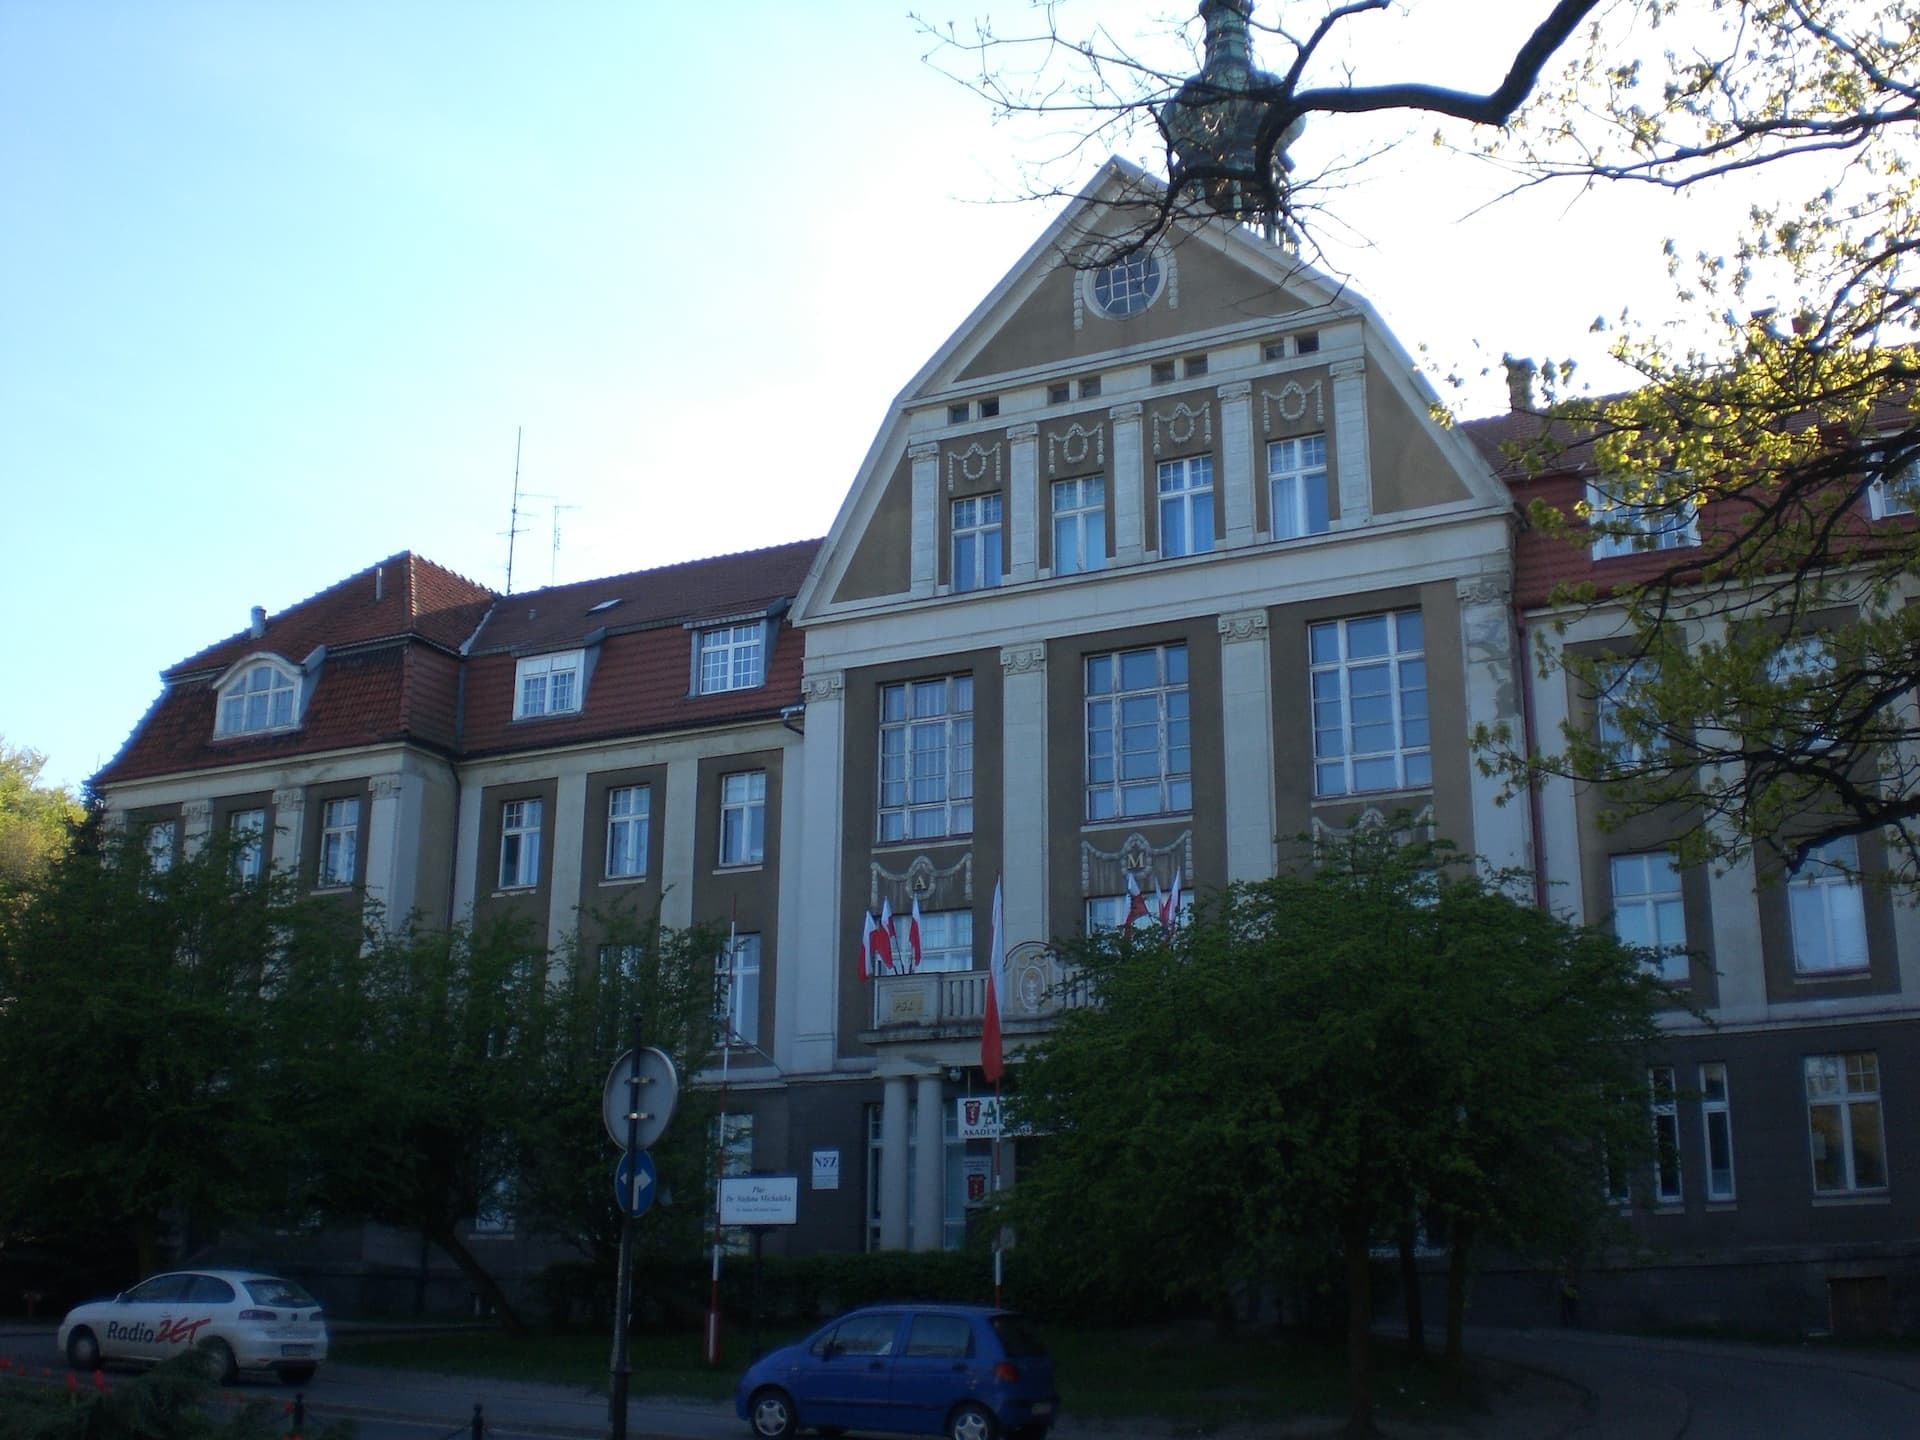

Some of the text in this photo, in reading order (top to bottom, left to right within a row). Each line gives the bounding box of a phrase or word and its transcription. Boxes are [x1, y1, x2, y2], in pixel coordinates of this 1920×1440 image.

[1126, 852, 1146, 870] M
[911, 876, 927, 892] A
[815, 1156, 837, 1168] NFZ
[107, 1317, 212, 1344] Radio ZET
